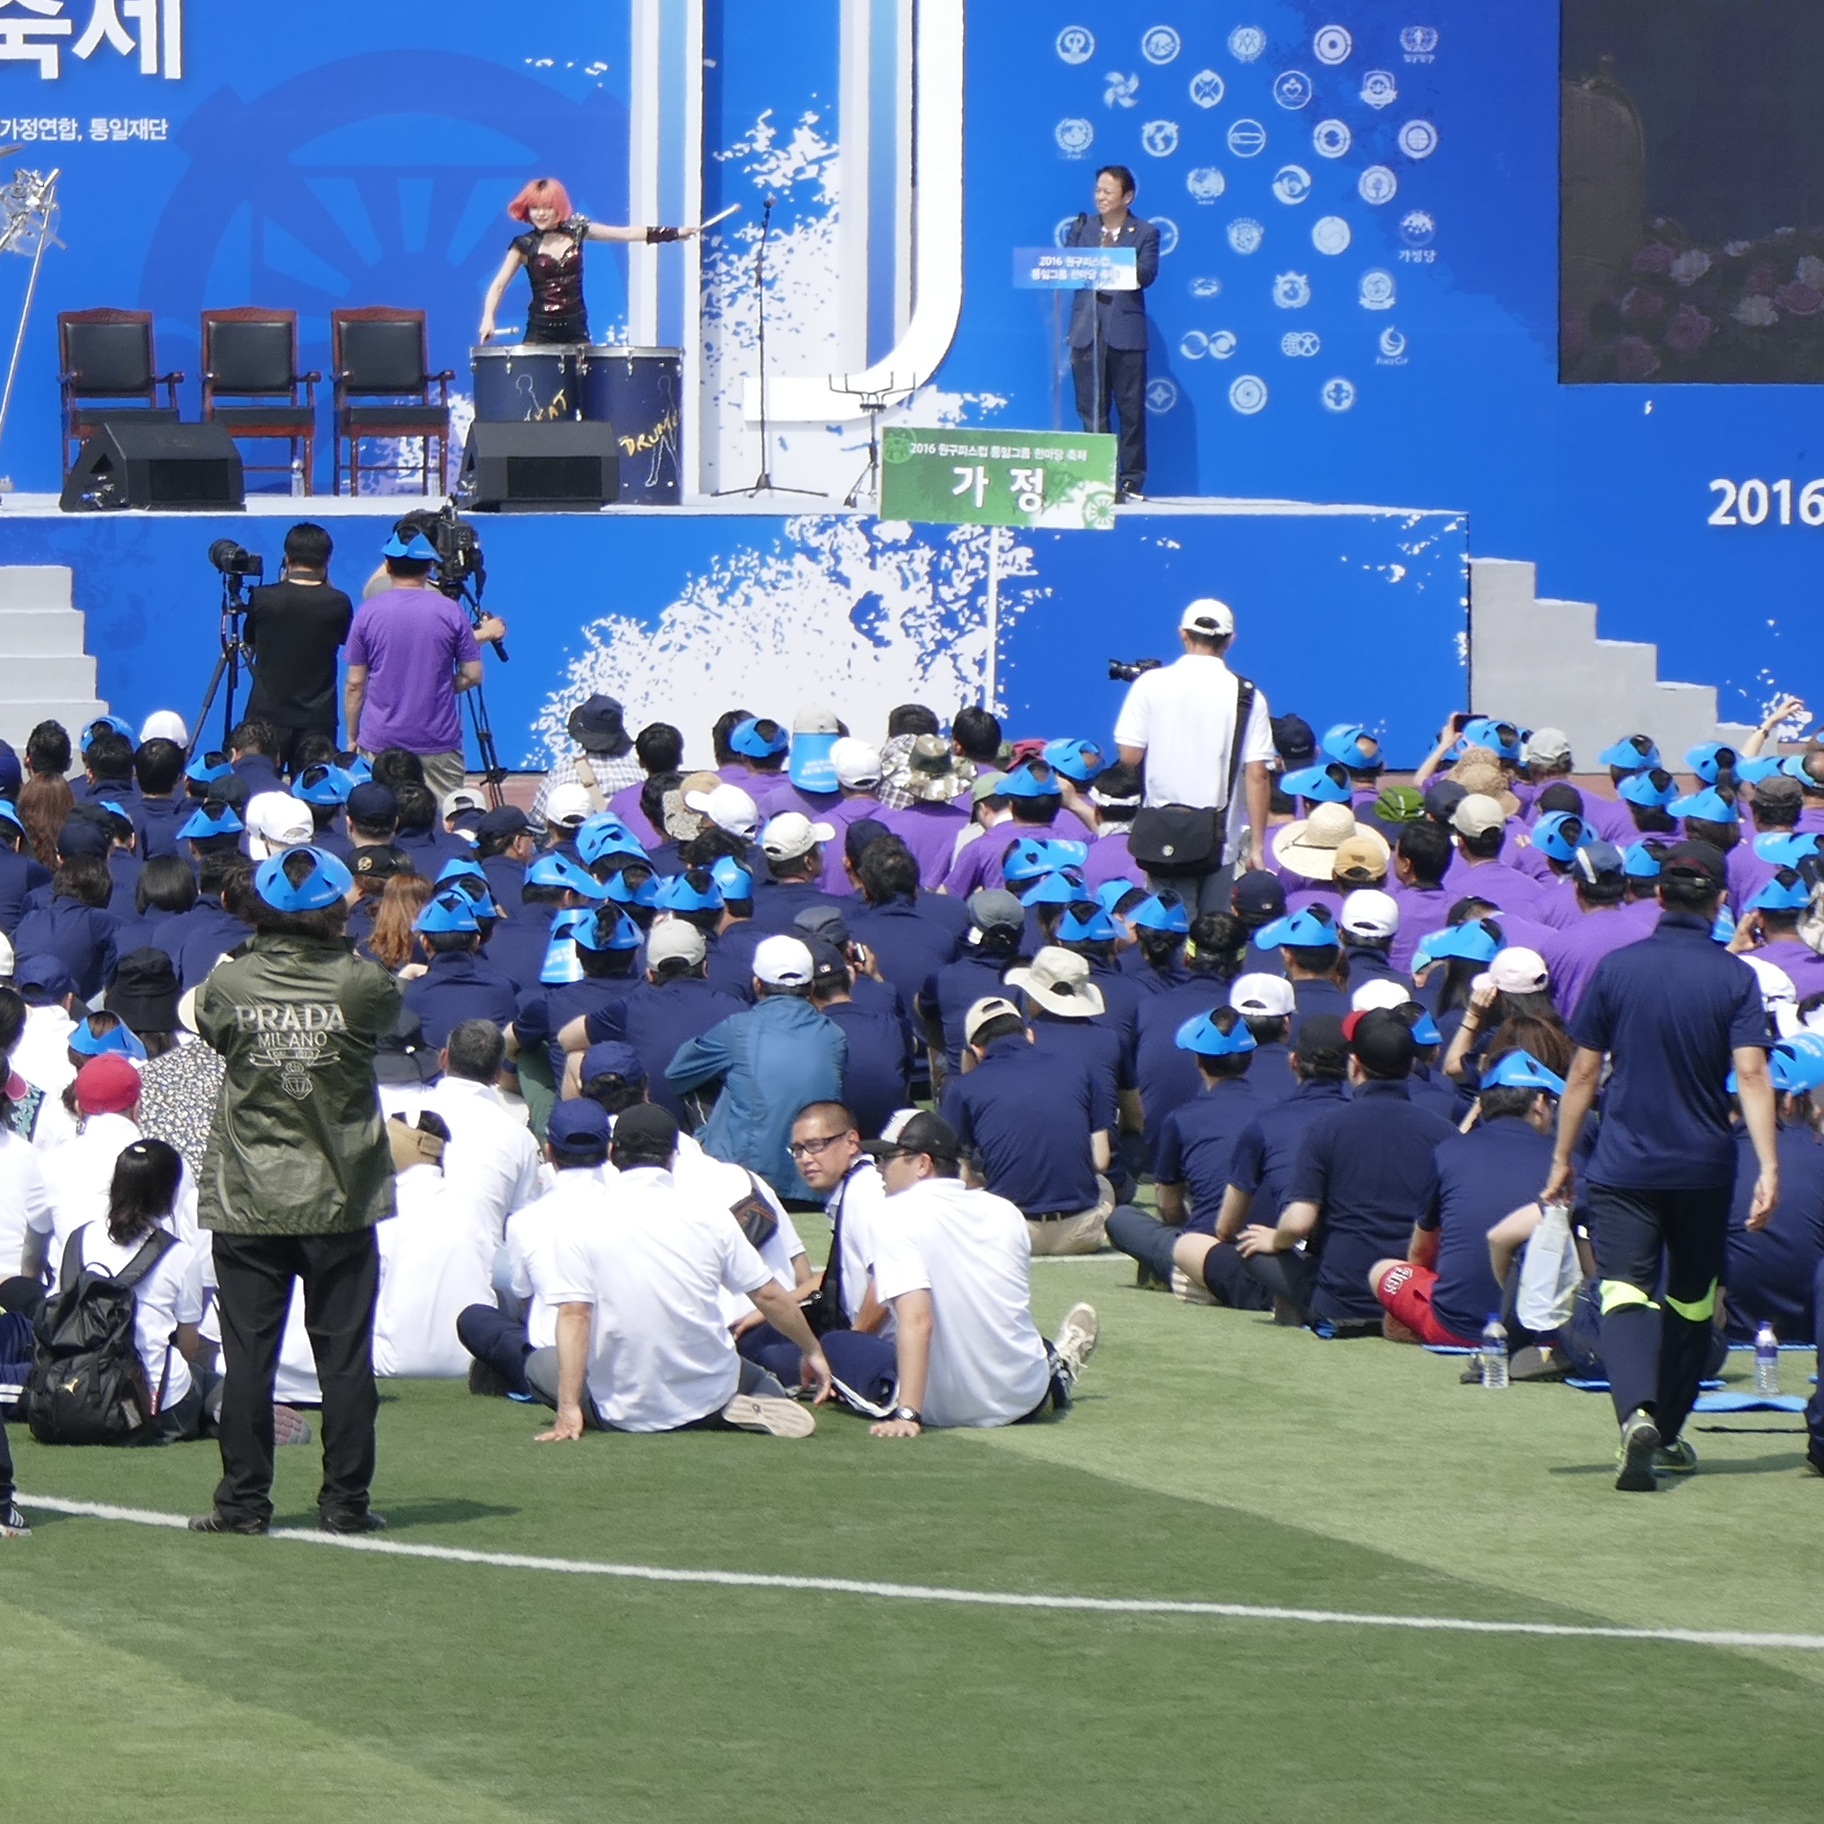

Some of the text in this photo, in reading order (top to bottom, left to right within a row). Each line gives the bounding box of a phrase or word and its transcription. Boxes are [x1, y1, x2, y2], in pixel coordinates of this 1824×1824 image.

[89, 119, 168, 141] 통일재단
[1708, 478, 1824, 526] 2016
[235, 1002, 349, 1032] PRADA
[257, 1031, 328, 1048] MILANO
